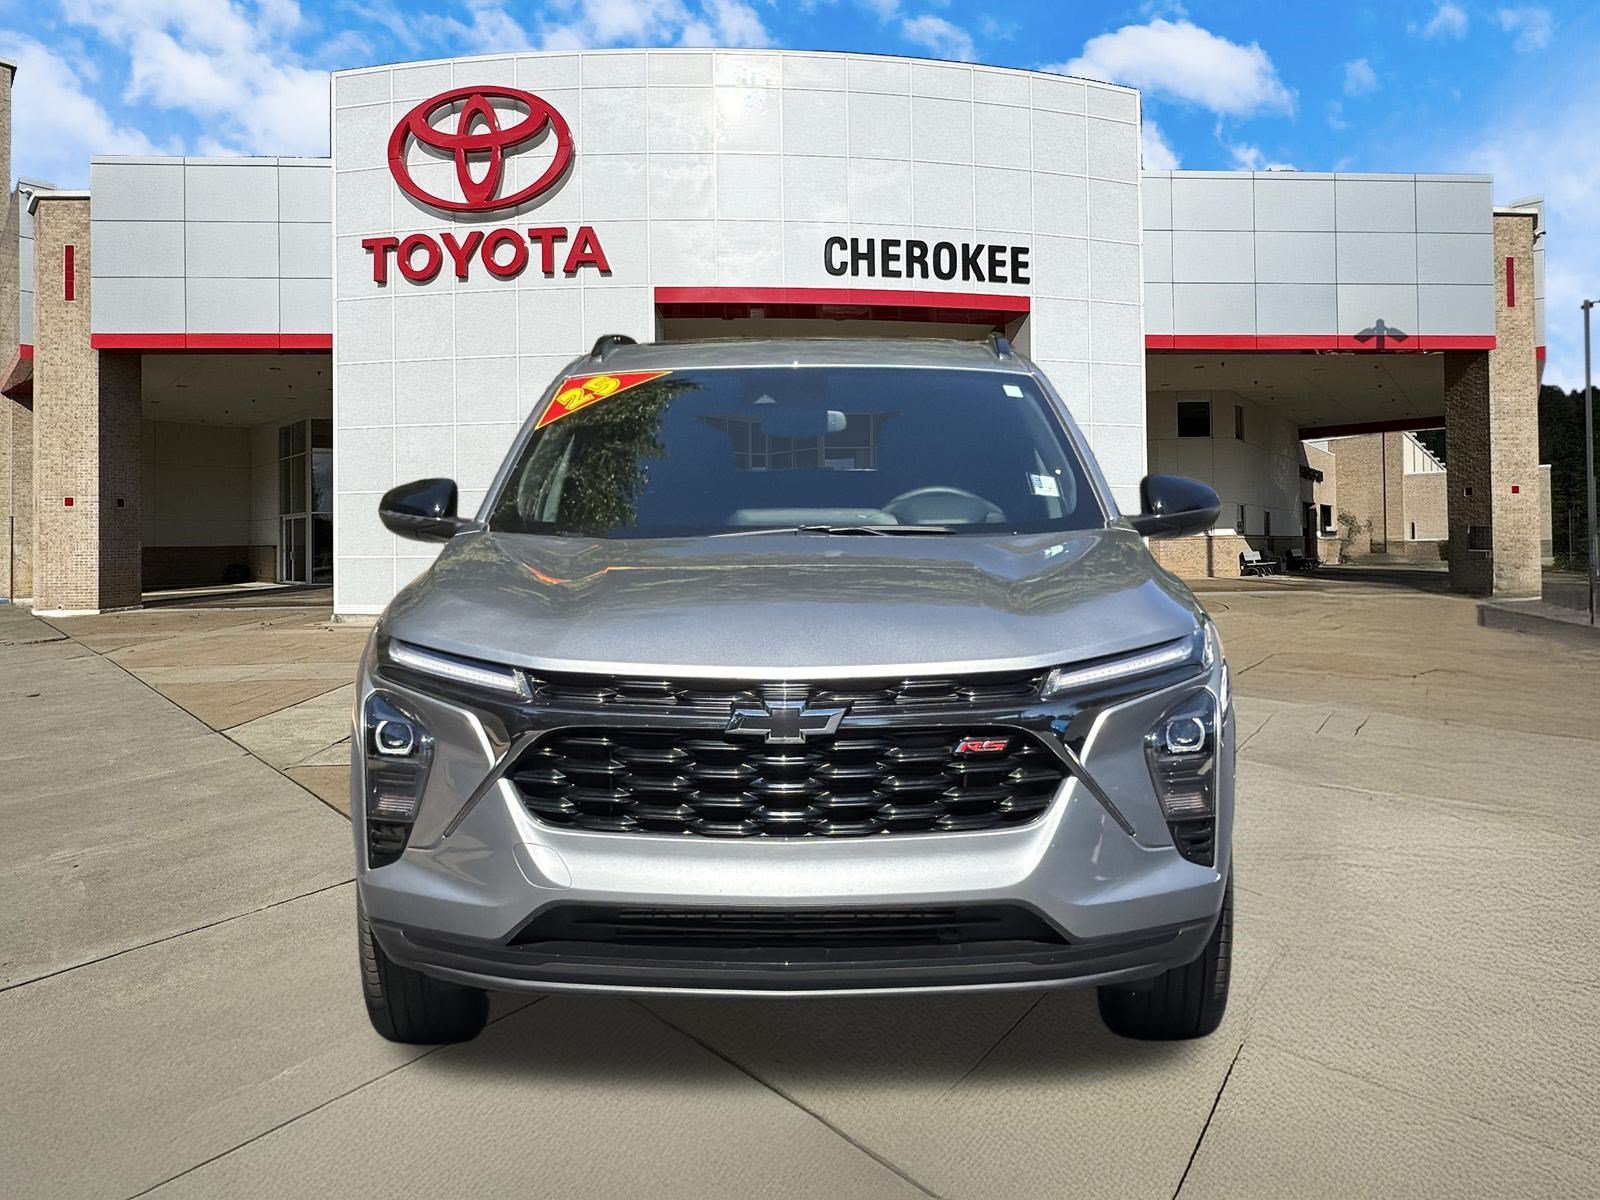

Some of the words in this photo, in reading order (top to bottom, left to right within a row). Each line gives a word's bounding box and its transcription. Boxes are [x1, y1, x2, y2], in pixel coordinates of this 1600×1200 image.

[362, 226, 612, 285] TOYOTA
[824, 236, 1031, 285] CHEROKEE
[556, 375, 621, 411] 25
[954, 739, 1009, 753] RS
